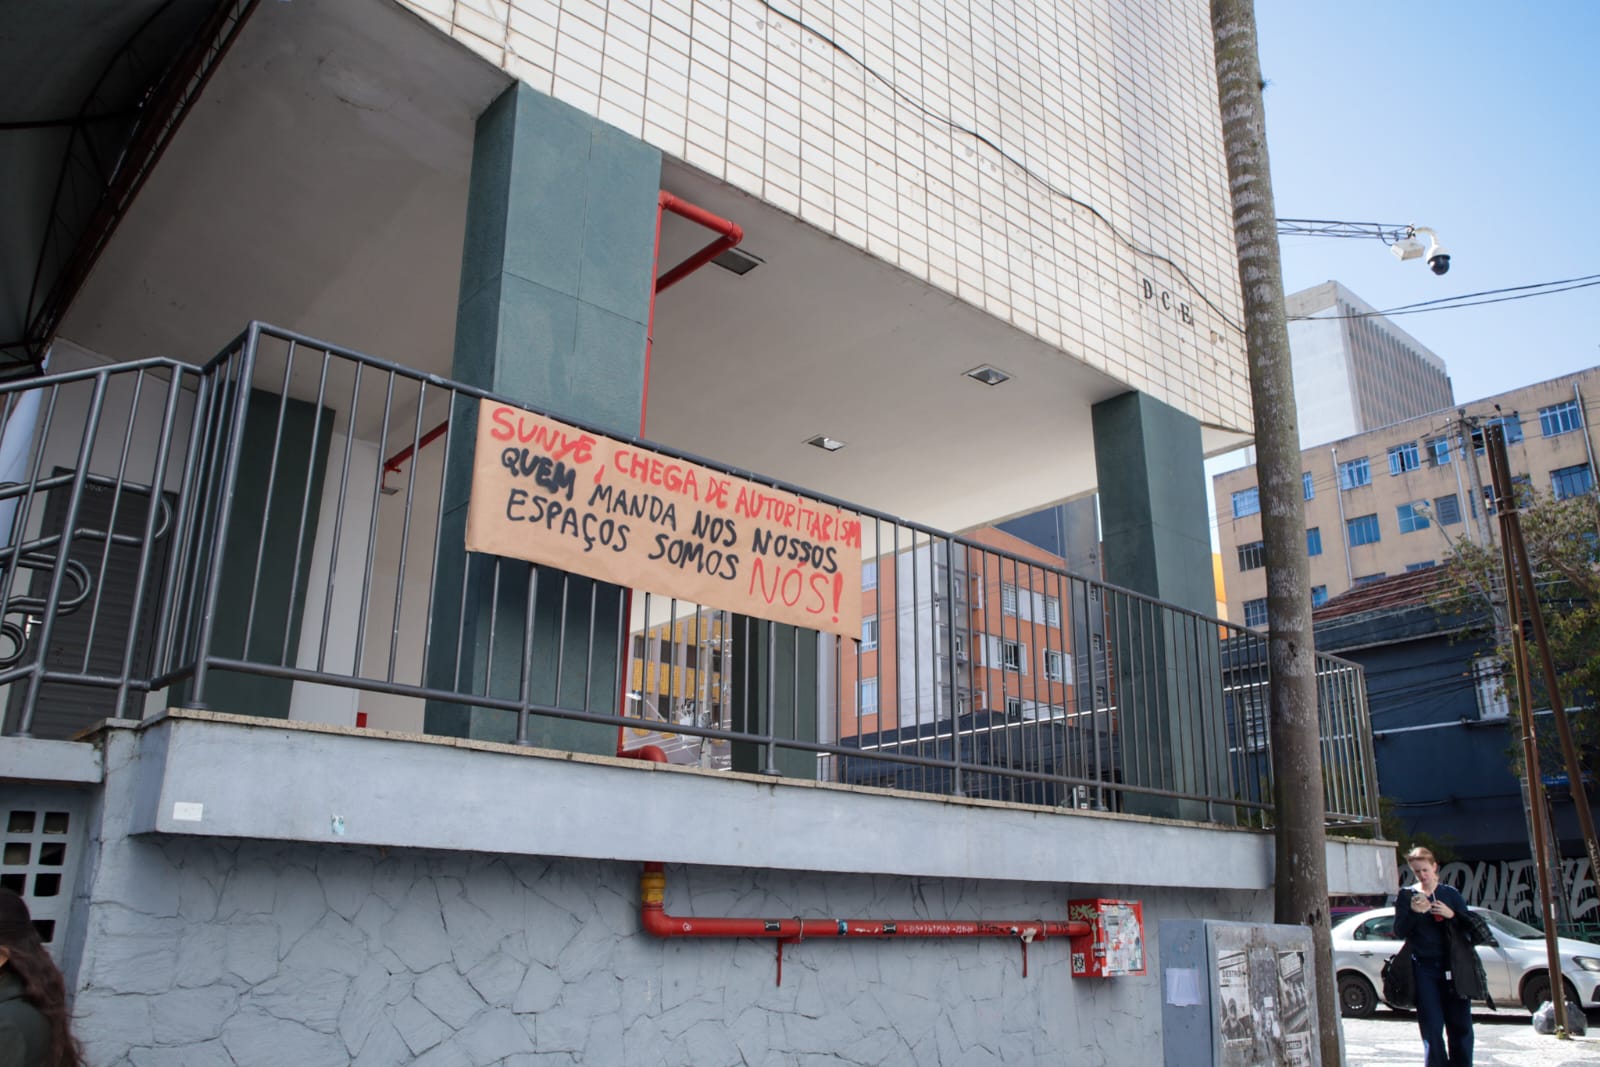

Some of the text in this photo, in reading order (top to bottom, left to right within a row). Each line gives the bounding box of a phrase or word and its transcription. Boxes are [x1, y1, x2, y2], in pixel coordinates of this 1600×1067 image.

[501, 447, 838, 574] QUEM MANDA NOS NOSSOS
[614, 449, 698, 502] CHEGA
[704, 476, 731, 509] DE
[506, 488, 630, 552] ESPAÇOS
[648, 533, 739, 580] SOMOS
